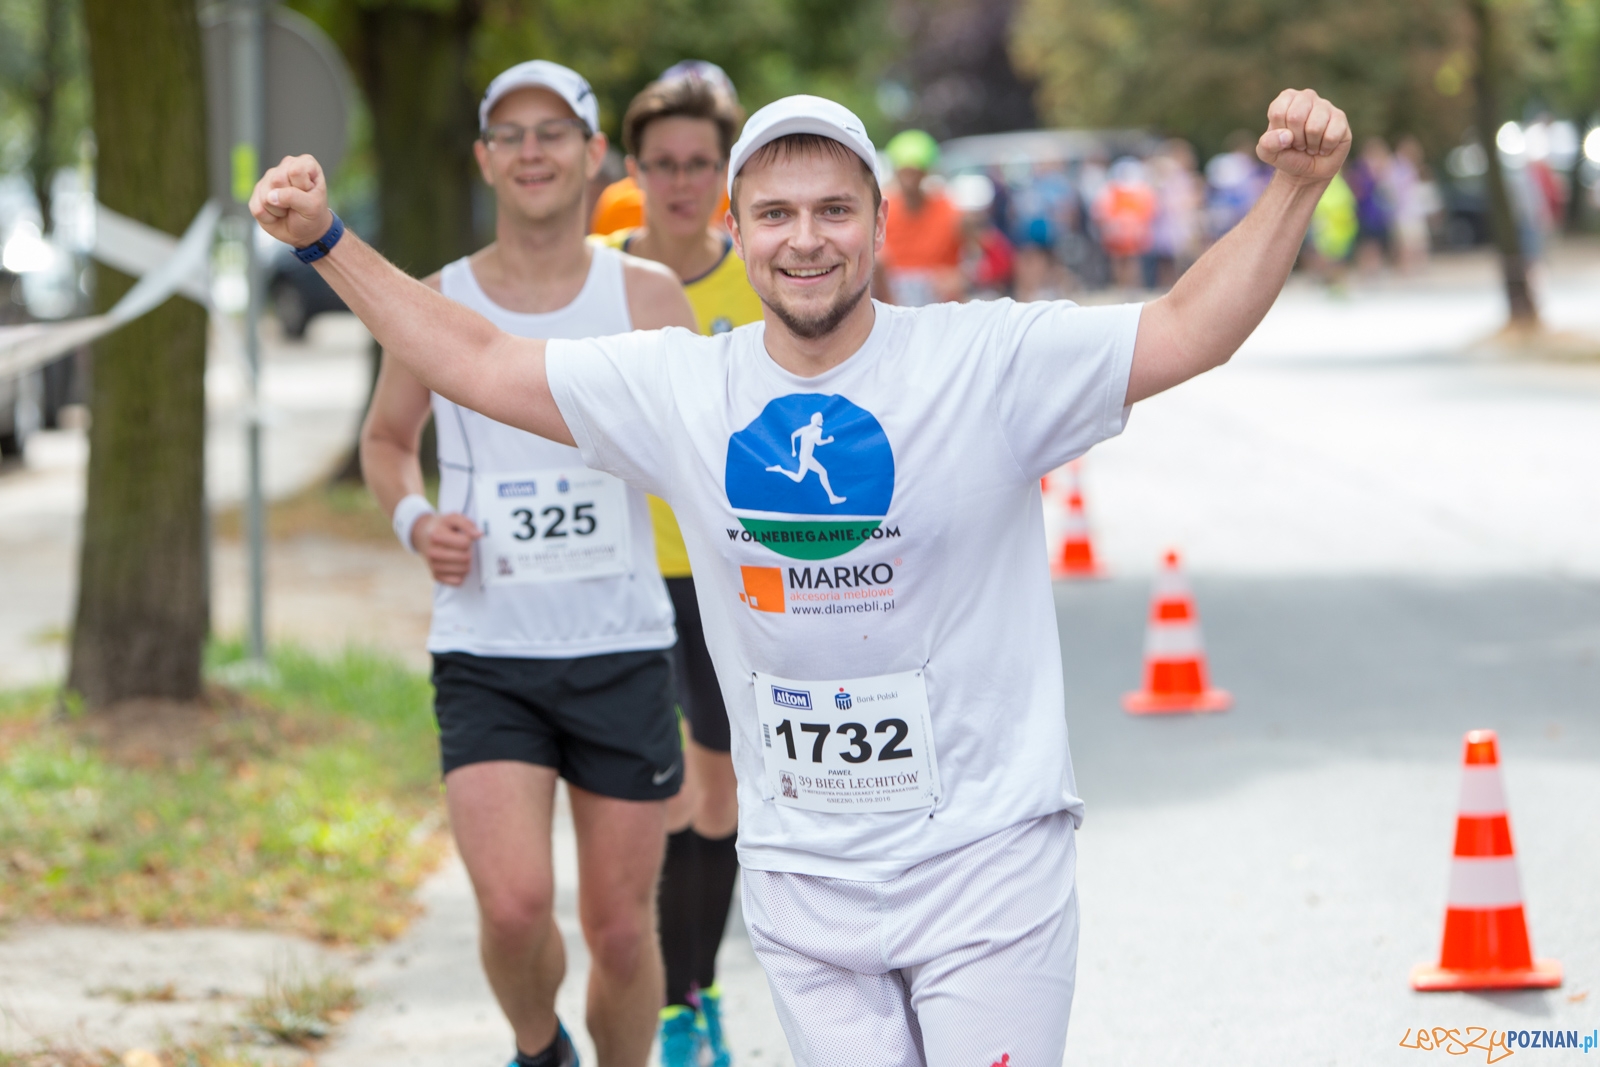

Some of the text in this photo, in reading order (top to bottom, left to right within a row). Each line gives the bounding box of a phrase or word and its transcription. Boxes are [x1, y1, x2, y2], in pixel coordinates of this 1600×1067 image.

[511, 502, 597, 541] 325
[726, 526, 901, 543] WOLNEBIEGANIE.COM
[788, 563, 894, 589] MARKO
[790, 588, 894, 601] akcesoria meblowe
[791, 599, 895, 615] www.dlamebli.pl
[856, 693, 875, 704] Bank
[877, 691, 898, 701] Polski
[775, 718, 913, 764] 1732
[798, 770, 919, 789] 39 BIEG LECHITÓW
